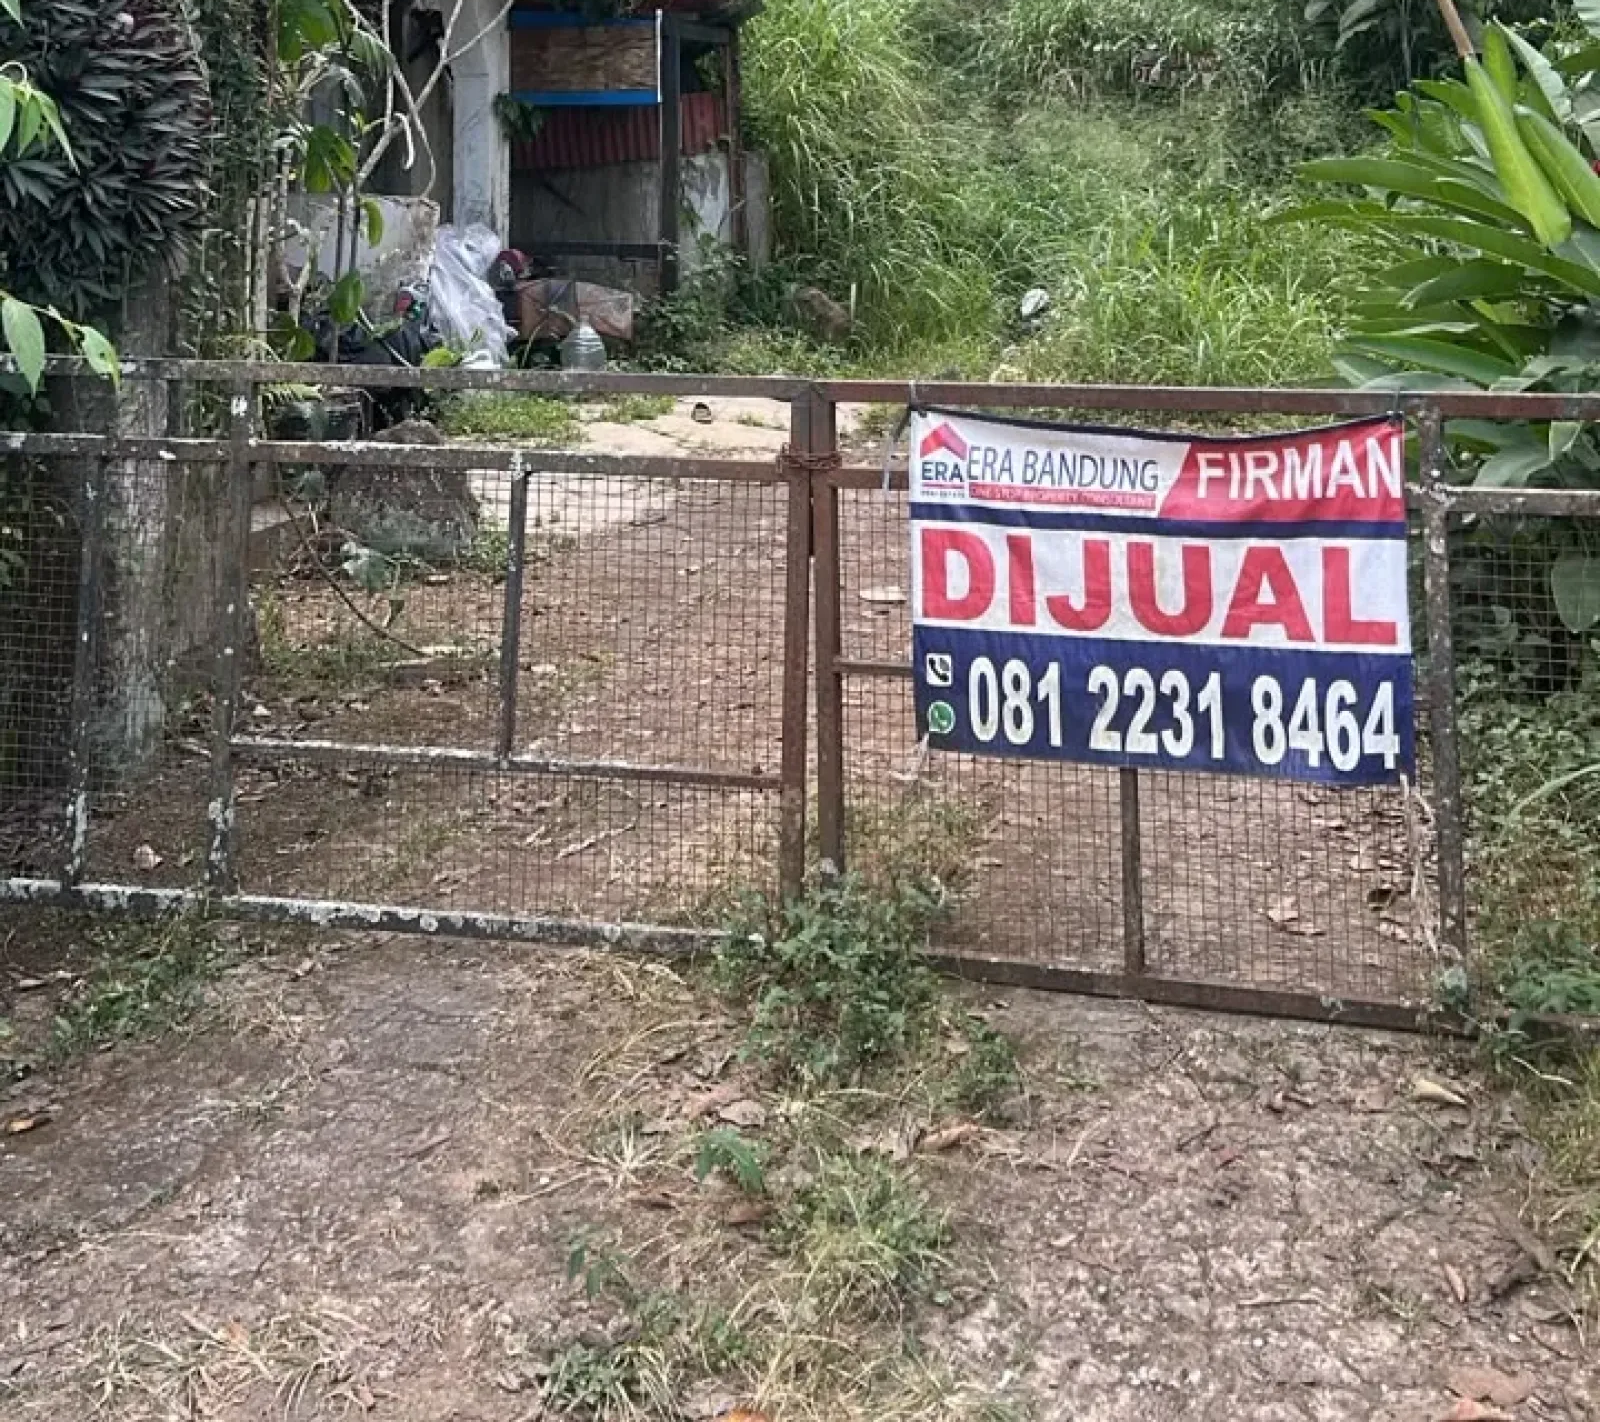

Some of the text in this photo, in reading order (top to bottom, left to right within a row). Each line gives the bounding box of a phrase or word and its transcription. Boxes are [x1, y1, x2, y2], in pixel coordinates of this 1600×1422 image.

[921, 461, 965, 482] ERA
[967, 446, 1160, 492] ERA BANDUNG
[1196, 438, 1401, 501] FIRMAN
[921, 527, 1397, 645] DIJUAL
[968, 656, 1401, 773] 081 2231 8464
